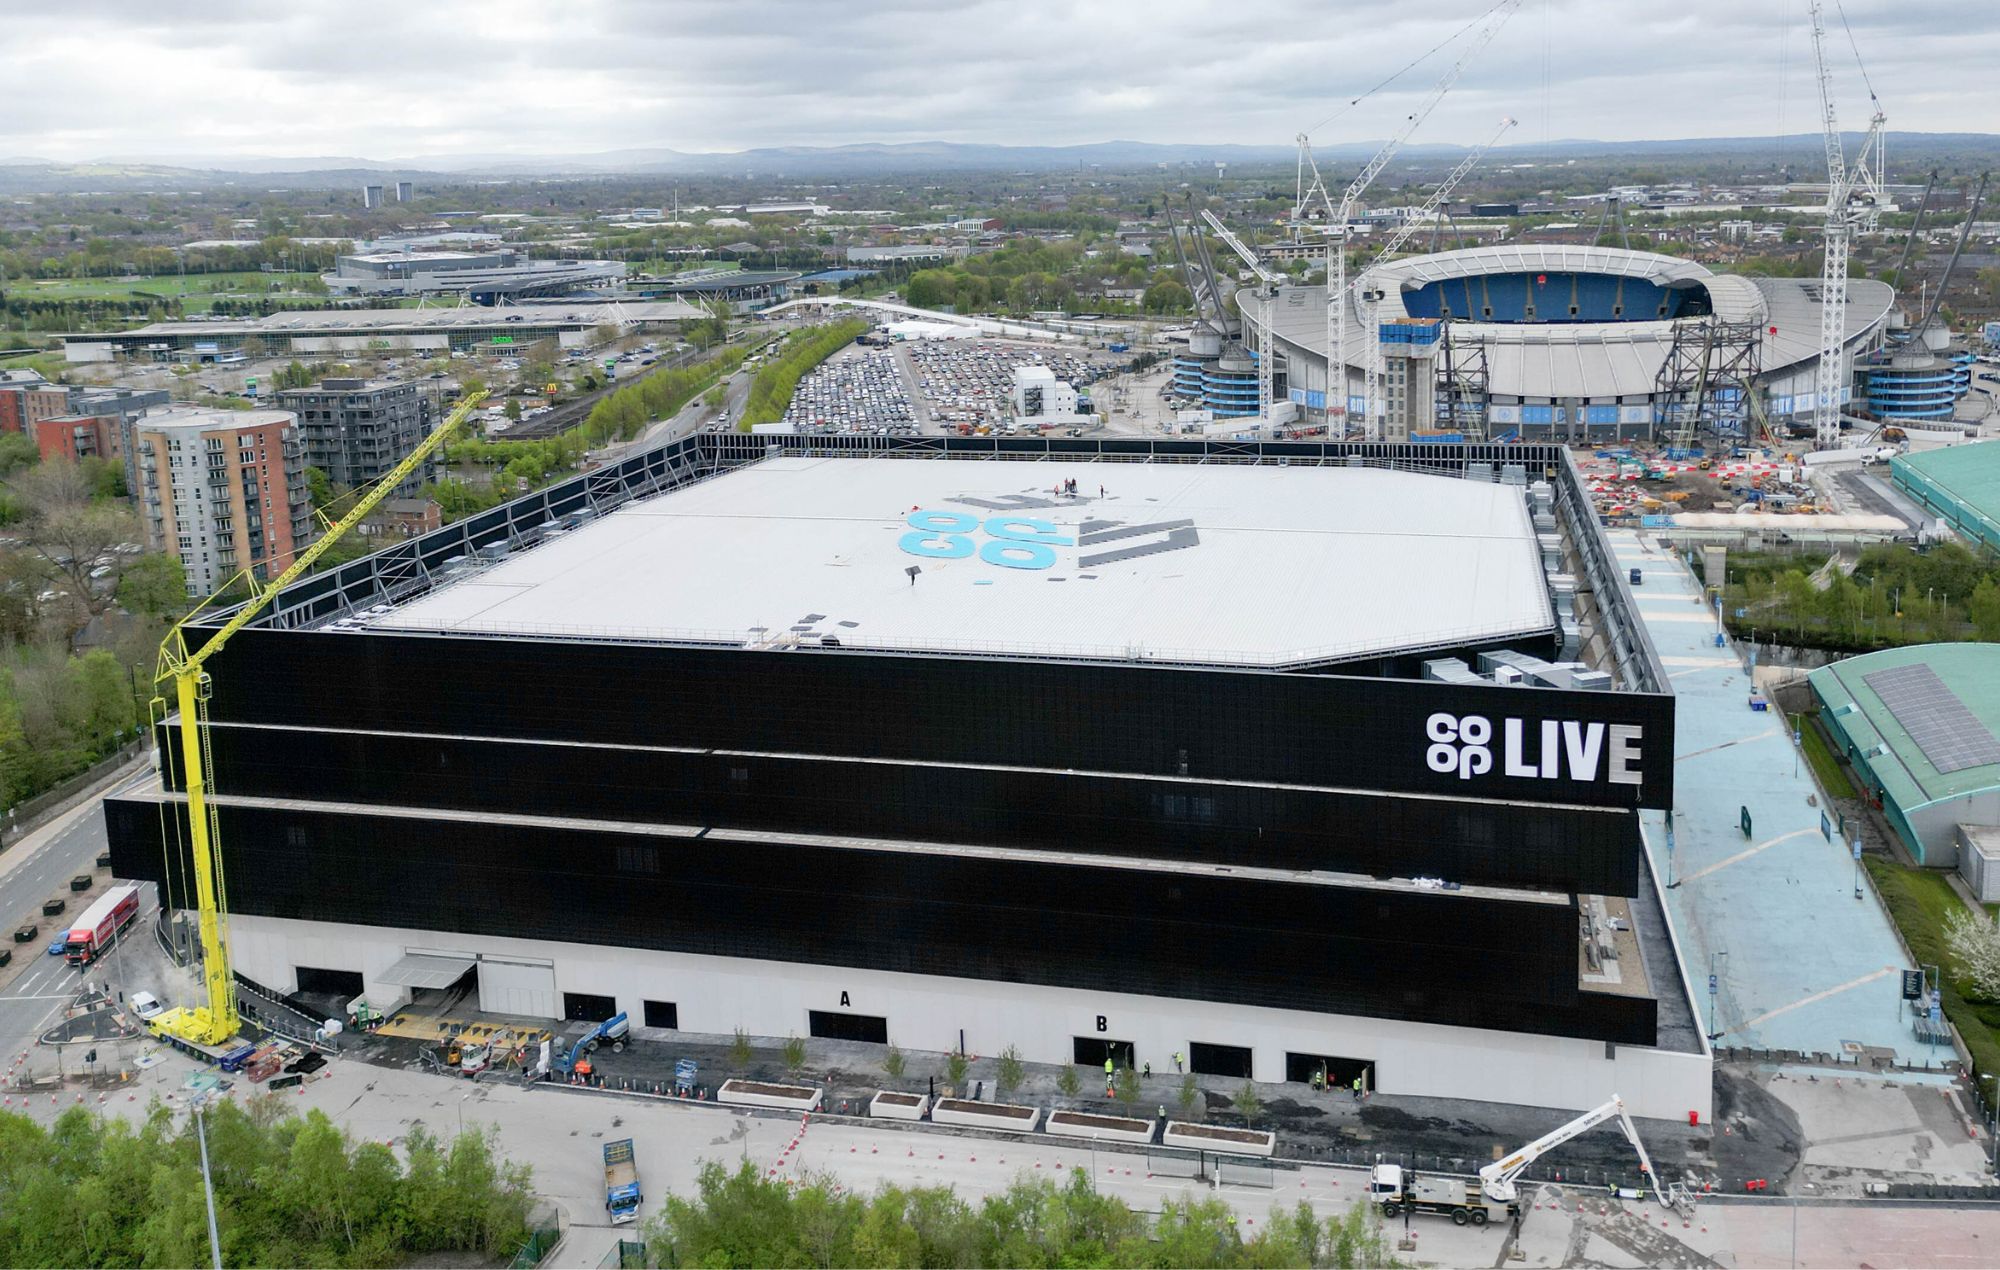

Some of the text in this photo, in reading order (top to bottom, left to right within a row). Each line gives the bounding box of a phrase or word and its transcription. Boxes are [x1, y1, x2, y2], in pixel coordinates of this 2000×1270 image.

[1505, 718, 1643, 785] LIVE
[840, 990, 851, 1007] A
[1096, 1015, 1108, 1032] B
